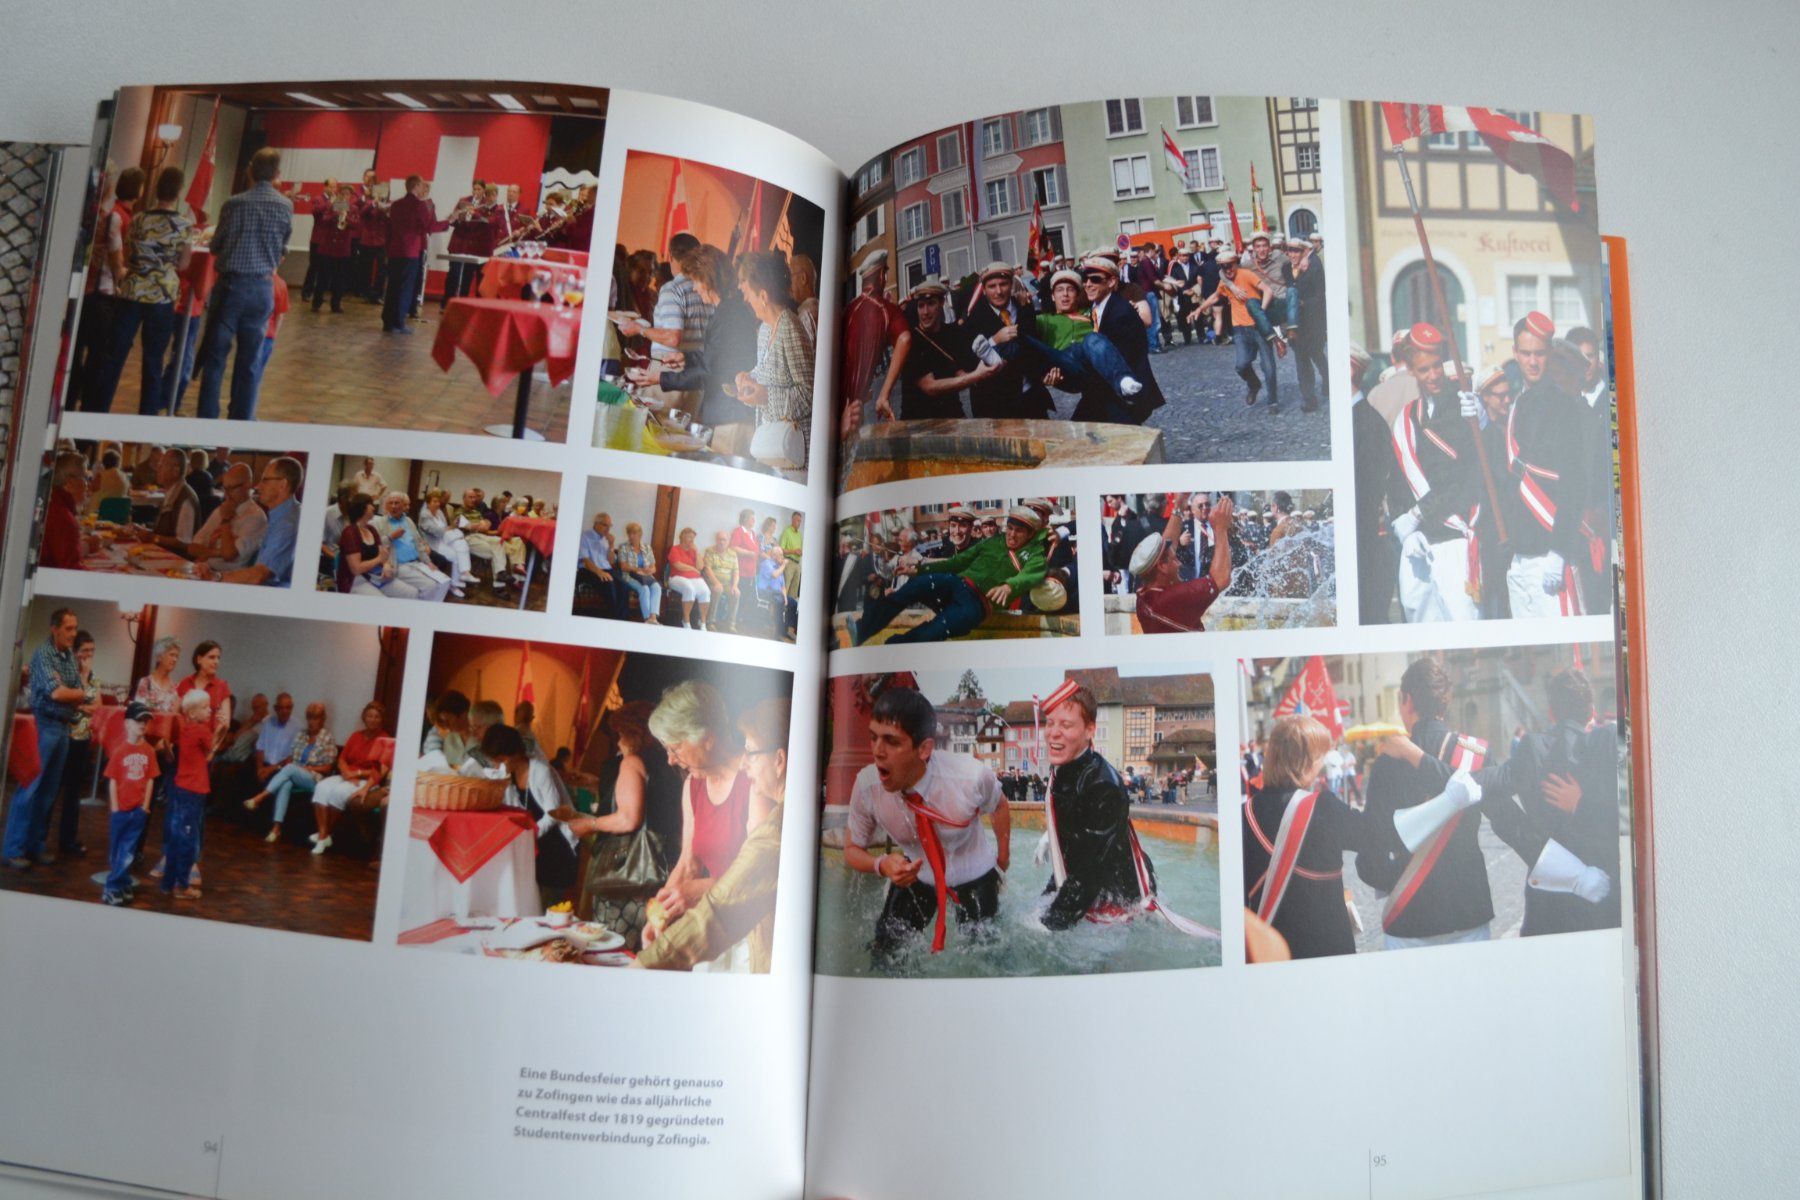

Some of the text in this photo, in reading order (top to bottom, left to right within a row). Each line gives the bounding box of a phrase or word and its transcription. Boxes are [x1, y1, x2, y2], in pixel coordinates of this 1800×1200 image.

[519, 1067, 724, 1090] Eine Bundesfeier gehört genauso
[517, 1088, 712, 1109] zu Zofingen wie das alljährliche
[515, 1106, 724, 1128] Centralfest der 1819 gegründeten
[513, 1125, 711, 1147] Studentenverbindung Zofingia.
[203, 1140, 218, 1154] 94
[1373, 1155, 1387, 1168] 95
